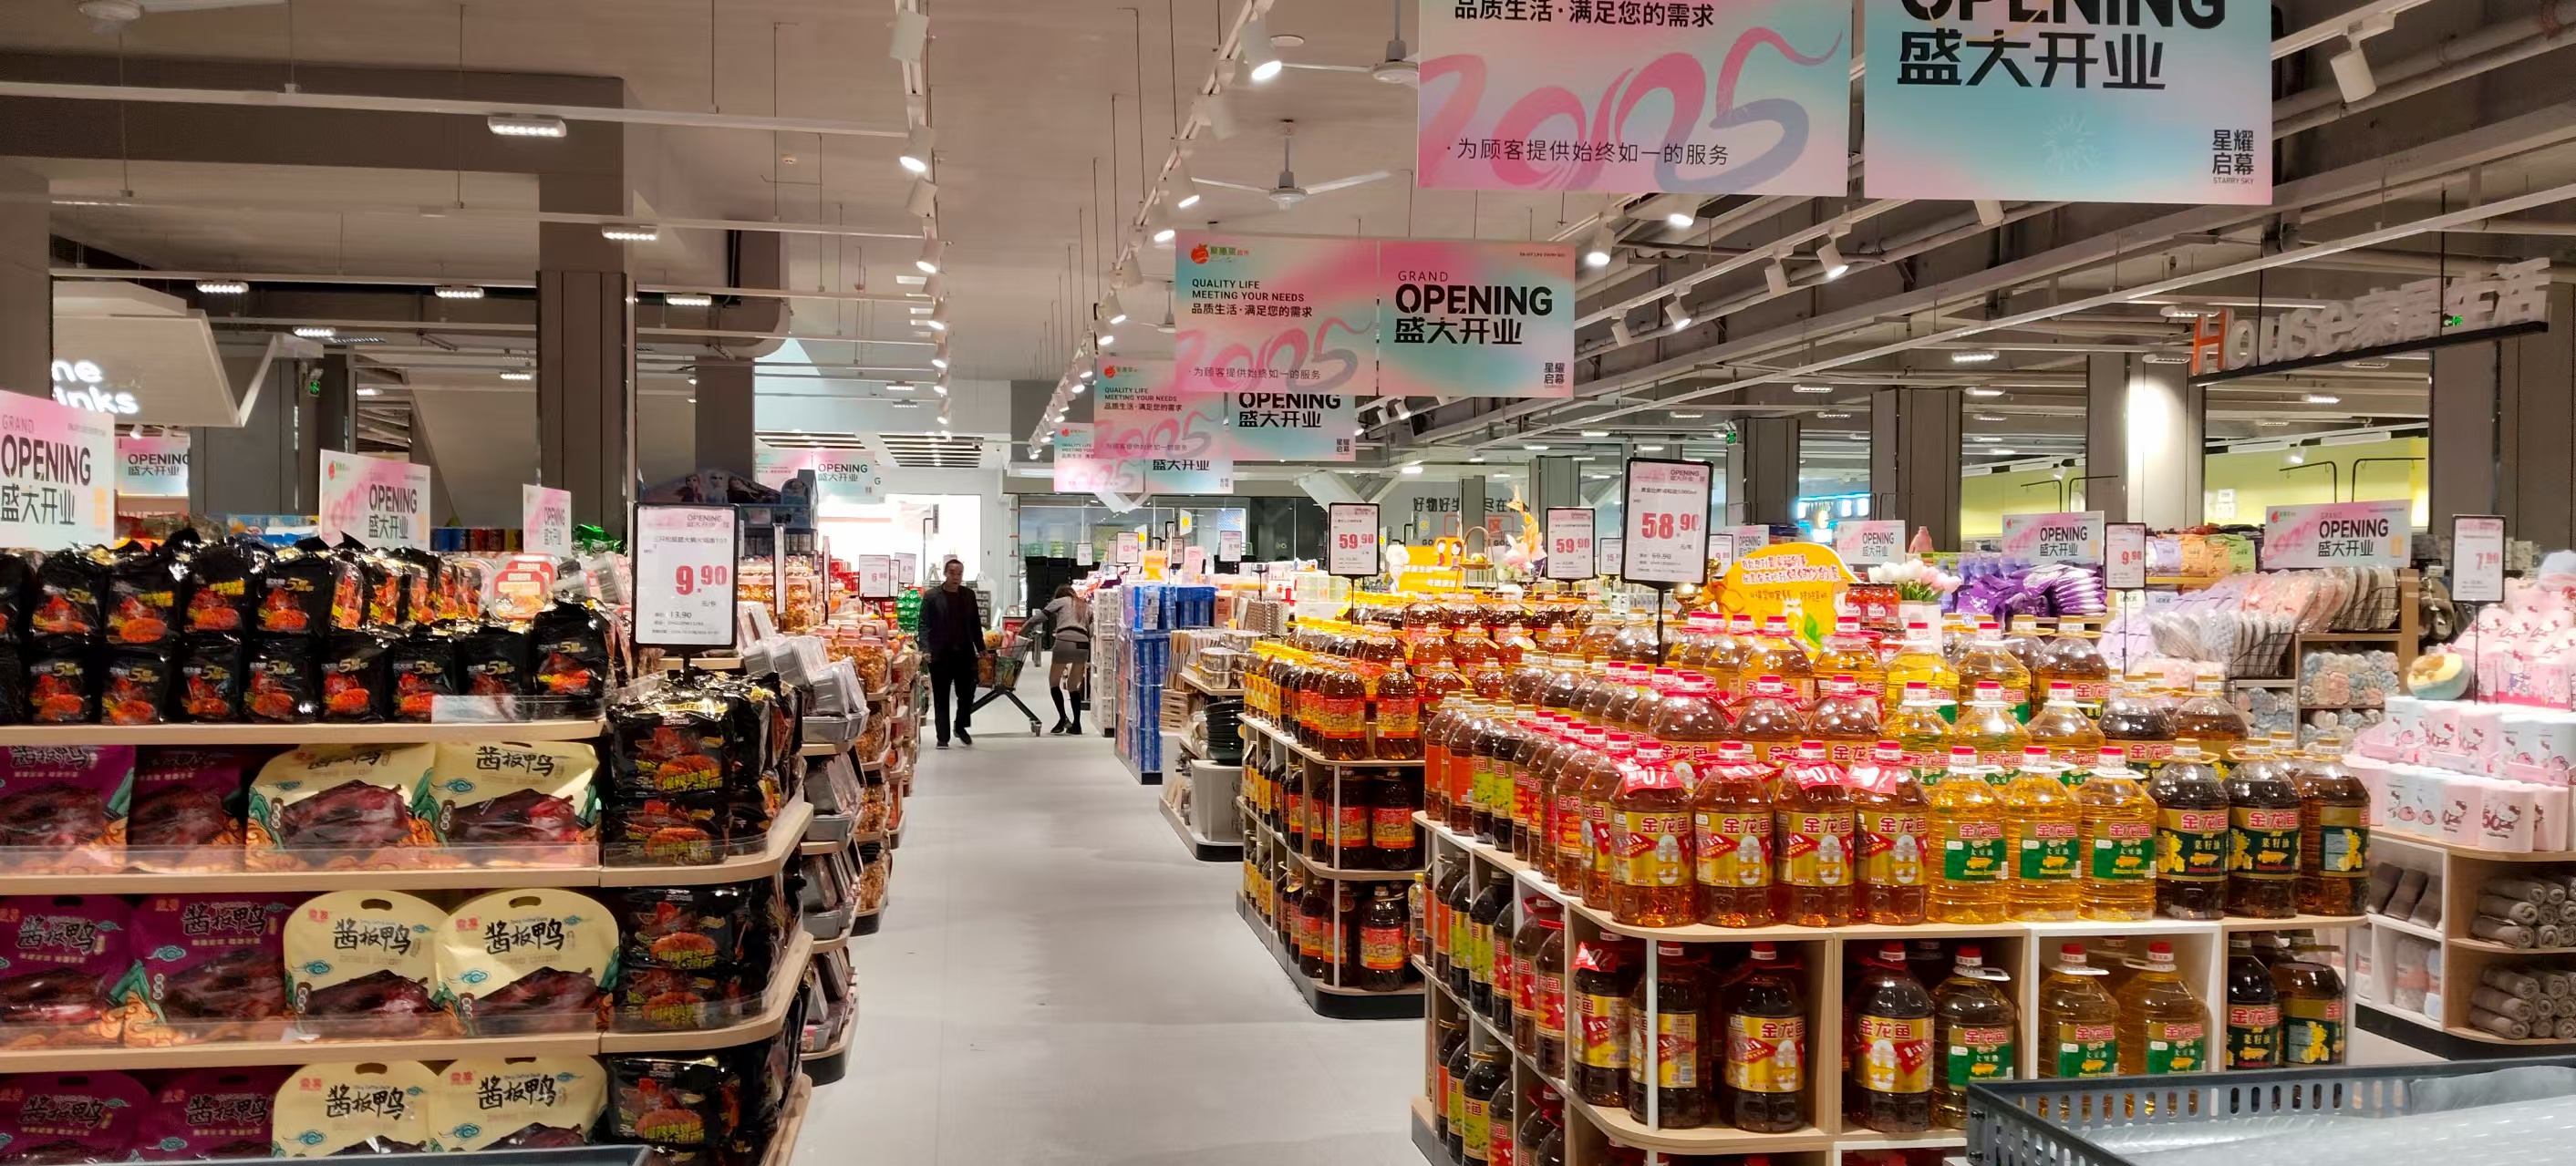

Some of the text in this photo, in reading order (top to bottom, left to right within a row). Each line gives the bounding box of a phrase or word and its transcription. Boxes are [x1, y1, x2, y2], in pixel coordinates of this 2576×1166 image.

[1898, 28, 2167, 89] 盛大开业
[2211, 129, 2255, 151] 星耀
[2211, 152, 2255, 175] 启幕
[1192, 279, 1260, 290] QUALITY LIFE
[1398, 270, 1448, 282] GRAND
[1192, 290, 1305, 302] MEETING YOUR NEEDS
[1395, 284, 1553, 316] OPENING
[1394, 316, 1523, 345] 盛大开业
[1238, 410, 1322, 428] 盛大开业
[2, 434, 91, 486] OPENING
[818, 463, 868, 473] OPENING
[1153, 459, 1210, 470] 盛大开业
[1, 482, 76, 525] 盛大开业
[368, 483, 417, 514] OPENING
[368, 514, 409, 540] 盛大开业
[1641, 512, 1701, 539] 58.90
[2039, 526, 2088, 542] OPENING
[2319, 518, 2389, 539] OPENING
[1339, 533, 1374, 549] 59.90
[1556, 538, 1590, 553] 59.90
[1738, 536, 1761, 547] OPENING
[1862, 531, 1895, 544] OPENING
[2039, 542, 2079, 557] 盛大开业
[2317, 538, 2374, 557] 盛大开业
[675, 564, 728, 595] 9.90
[475, 746, 555, 778] 酱板鸭
[1641, 816, 1689, 834] 金龙鱼
[1722, 817, 1770, 834] 金龙鱼
[1803, 816, 1851, 834] 金龙鱼
[1879, 816, 1927, 833] 金龙鱼
[2181, 813, 2229, 831] 金龙鱼
[2250, 811, 2298, 829] 金龙鱼
[1960, 823, 2002, 838] 金龙鱼
[2035, 823, 2078, 838] 金龙鱼
[2109, 823, 2152, 838] 金龙鱼
[182, 901, 267, 935] 酱板鸭
[16, 914, 97, 955] 酱板鸭
[333, 917, 412, 955] 酱板鸭
[483, 917, 565, 955] 酱板鸭
[2230, 1007, 2279, 1025] 金龙鱼
[1762, 1021, 1805, 1039] 金龙鱼
[1860, 1018, 1911, 1040] 金龙鱼
[1964, 1028, 2007, 1044] 金龙鱼
[2075, 1025, 2116, 1041] 金龙鱼
[2165, 1023, 2205, 1039] 金龙鱼
[326, 1084, 405, 1120] 酱板鸭
[478, 1075, 556, 1111] 酱板鸭
